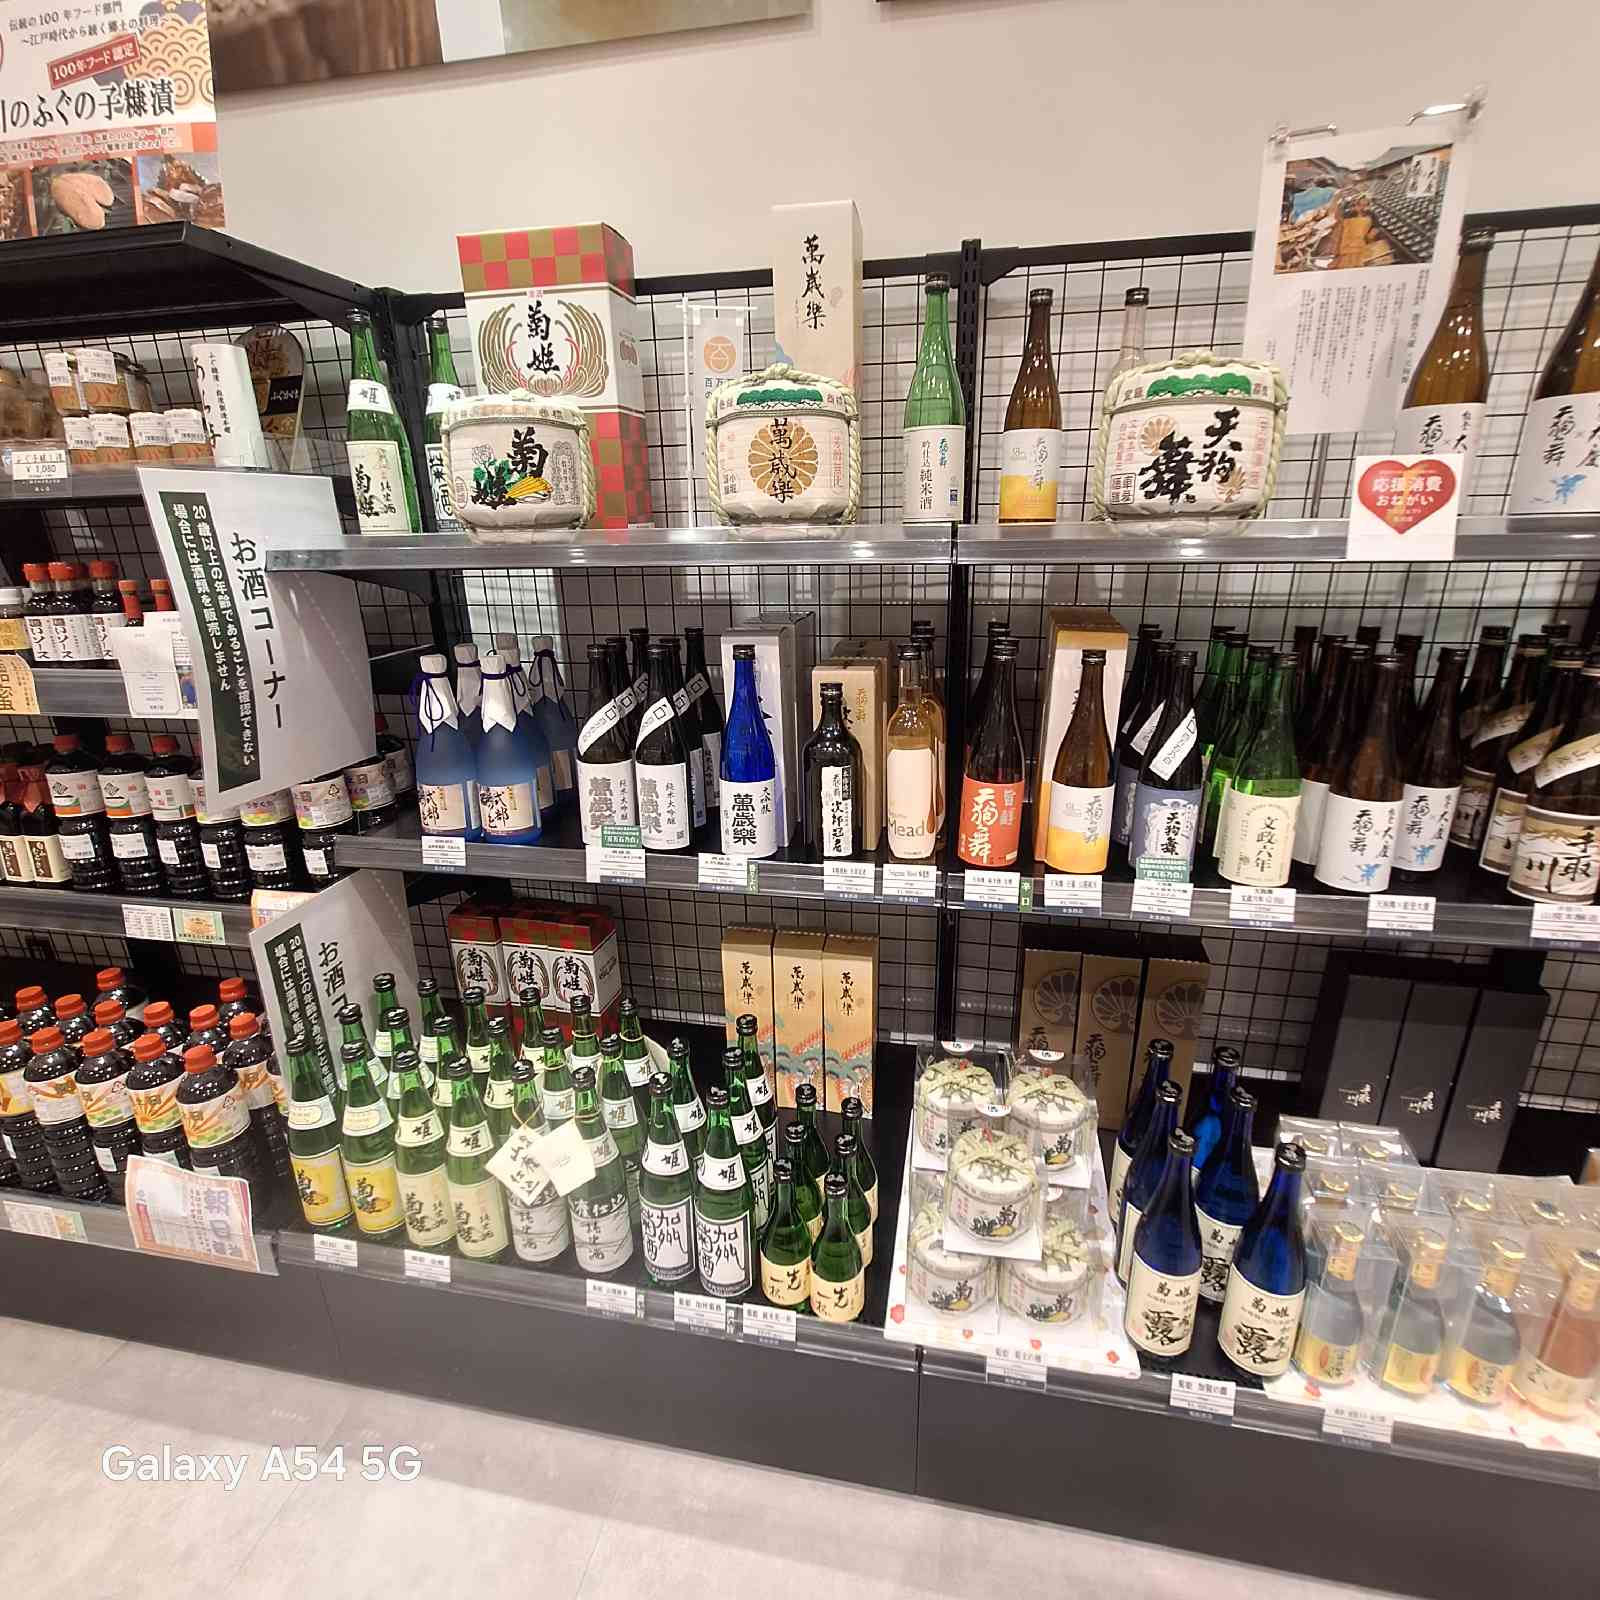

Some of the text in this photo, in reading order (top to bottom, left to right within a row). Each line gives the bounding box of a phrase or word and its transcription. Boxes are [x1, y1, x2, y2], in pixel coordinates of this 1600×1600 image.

[172, 503, 232, 692] 場合には酒類を販売しません
[230, 532, 287, 729] お酒コーナー
[1254, 815, 1280, 874] 文政六年
